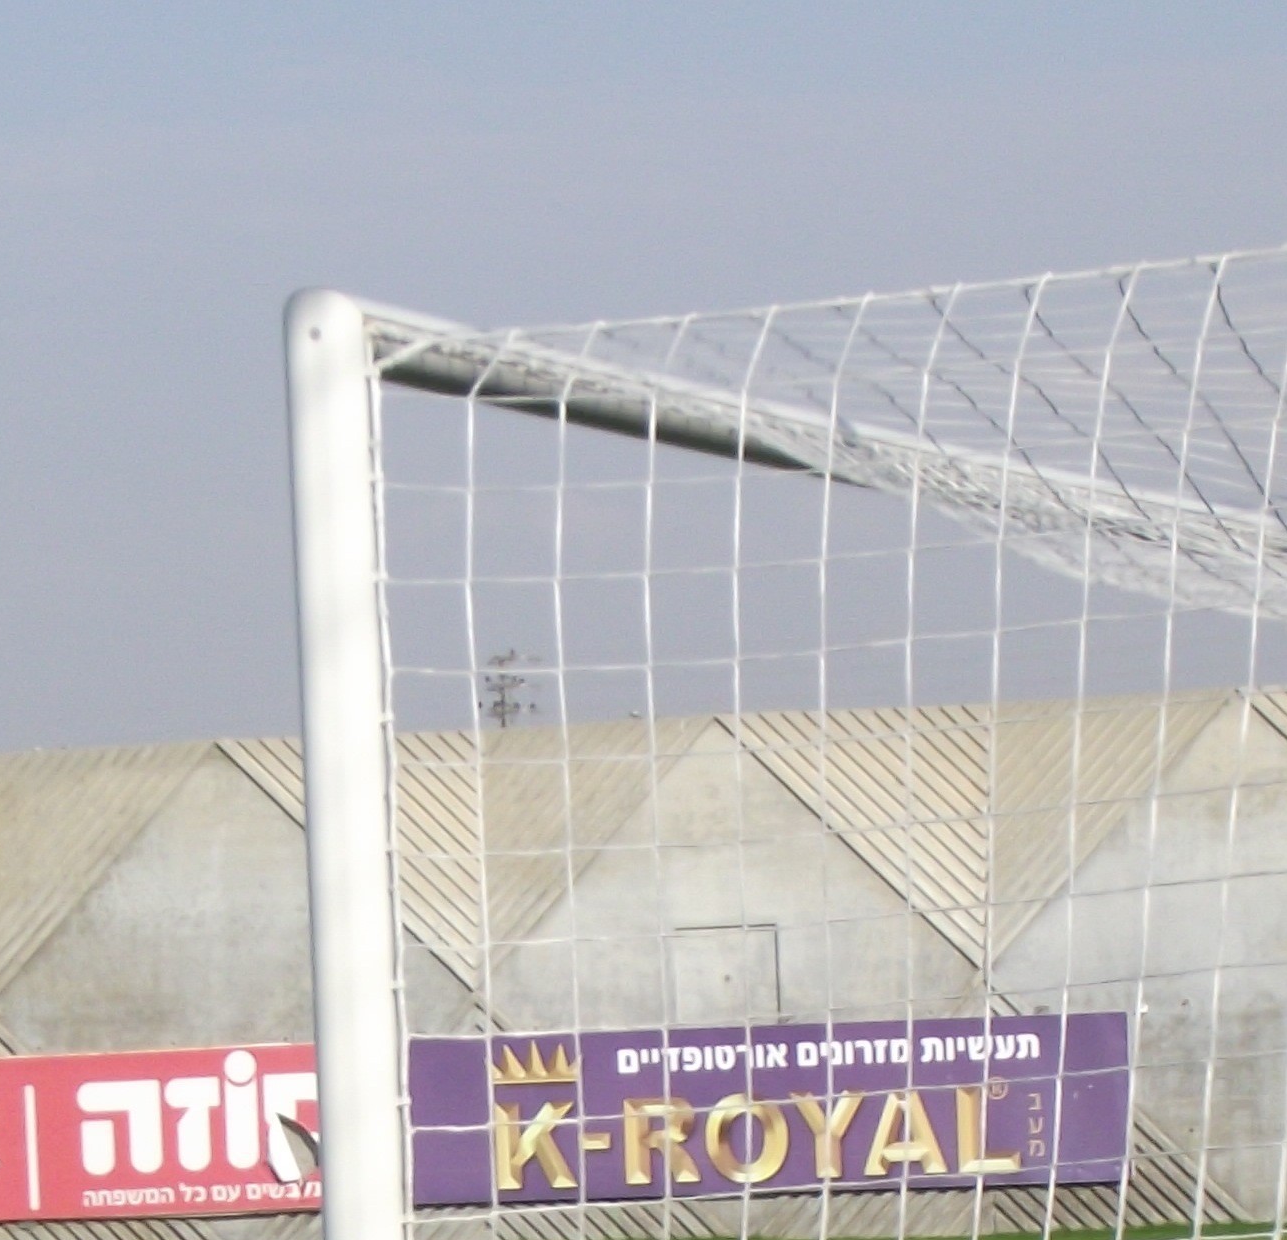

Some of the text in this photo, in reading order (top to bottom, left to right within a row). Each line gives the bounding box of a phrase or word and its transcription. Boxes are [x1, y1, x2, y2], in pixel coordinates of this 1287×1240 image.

[617, 1033, 1041, 1074] תעשיות מזרונים אורטופדיים
[493, 1086, 1022, 1190] K-ROYAL
[178, 1182, 208, 1203] כל
[212, 1183, 241, 1203] עם
